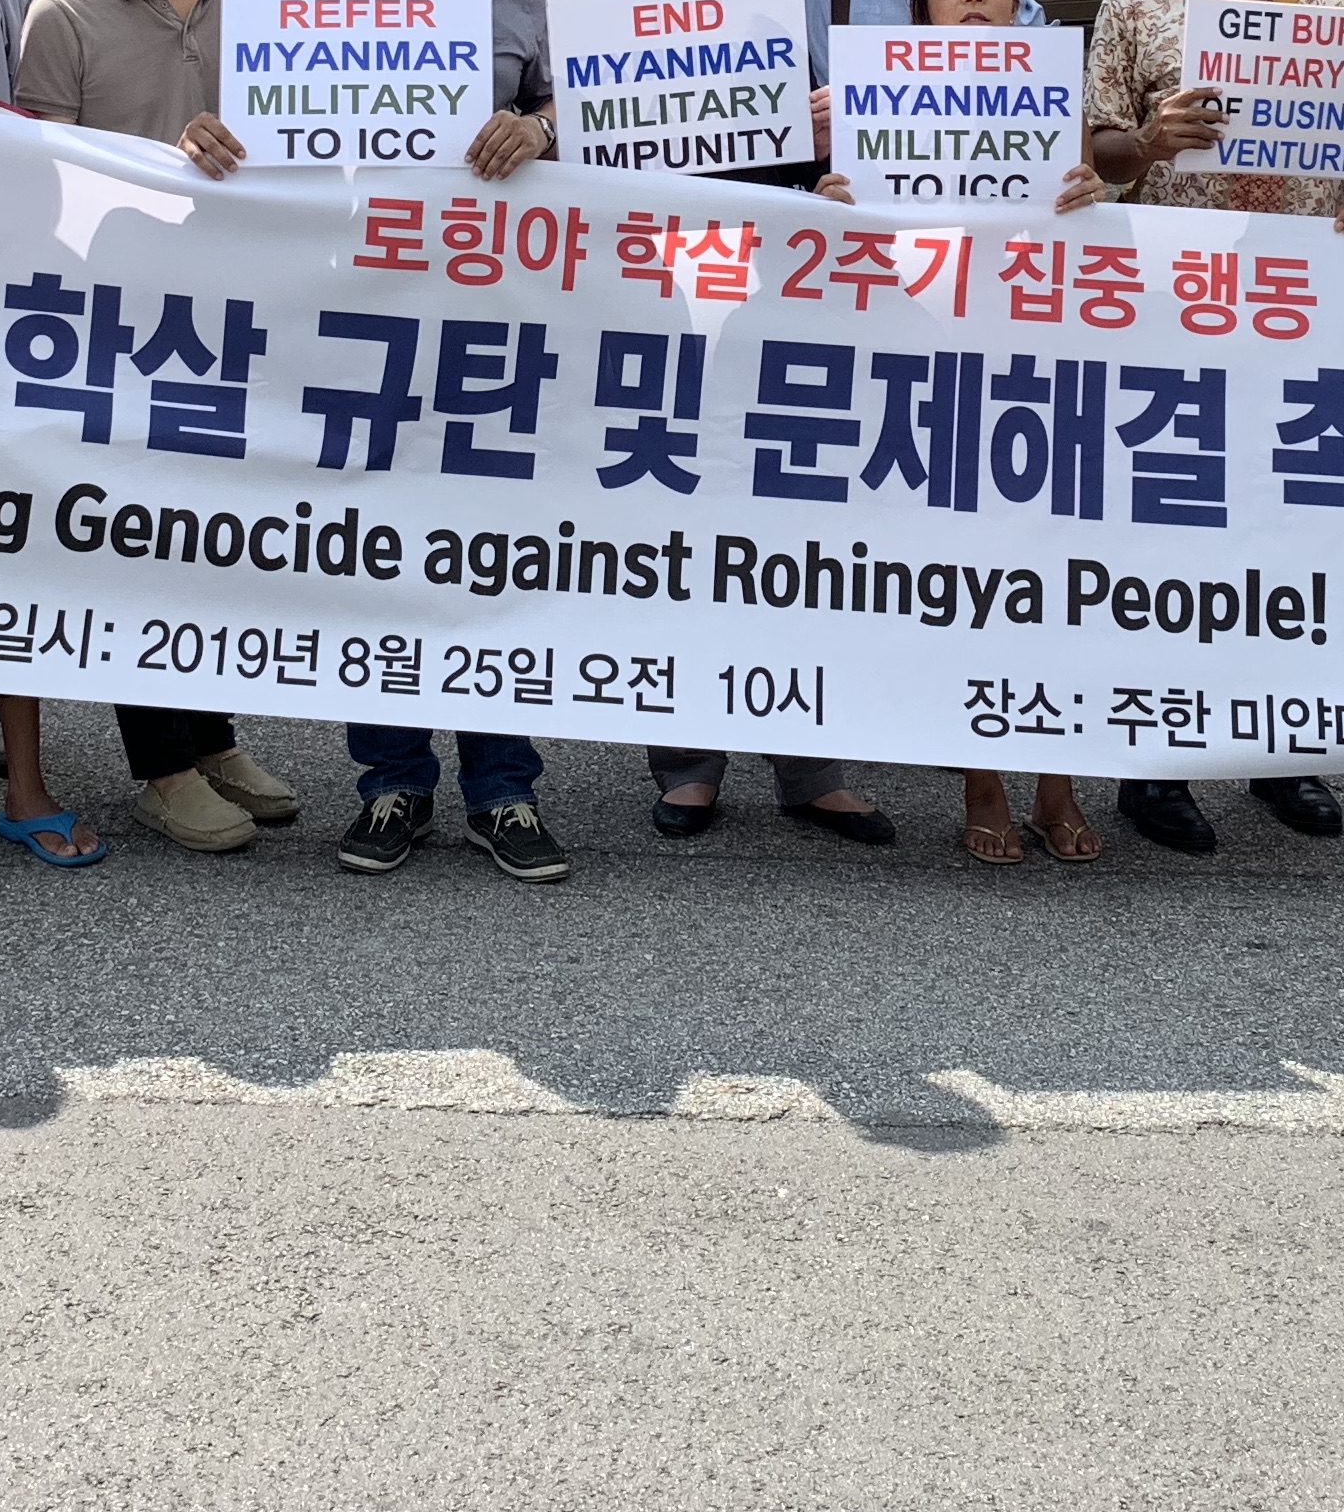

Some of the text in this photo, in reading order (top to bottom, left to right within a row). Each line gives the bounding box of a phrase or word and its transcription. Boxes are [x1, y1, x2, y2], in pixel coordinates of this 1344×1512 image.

[632, 0, 724, 37] END
[1218, 8, 1283, 41] GET
[236, 40, 480, 73] MYANMAR
[566, 37, 796, 88] MYANMAR
[884, 40, 1034, 73] REFER
[247, 84, 470, 116] MILITARY
[581, 82, 788, 133] MILITARY
[844, 84, 1071, 118] MYANMAR
[1201, 97, 1243, 124] OF
[277, 127, 436, 160] TO ICC
[583, 126, 792, 170] IMPUNITY
[856, 129, 1061, 161] MILITARY
[884, 174, 1030, 202] TO ICC
[354, 196, 1317, 340] 로힝야 학살 2주기 집중 행동
[4, 272, 268, 460] 학살
[301, 310, 559, 481] 규탄
[594, 330, 708, 496] 및
[743, 338, 1228, 529] 문제해결
[56, 482, 403, 580] Genocide
[423, 522, 692, 603] against
[712, 533, 1044, 630] Rohingya
[1066, 558, 1328, 646] People!
[136, 618, 320, 689] 2019년
[338, 634, 423, 696] 8월
[441, 645, 555, 704] 25일
[572, 653, 677, 715] 오전
[718, 664, 827, 726] 10시
[963, 677, 1085, 739] 장소:
[1106, 683, 1212, 748] 주한
